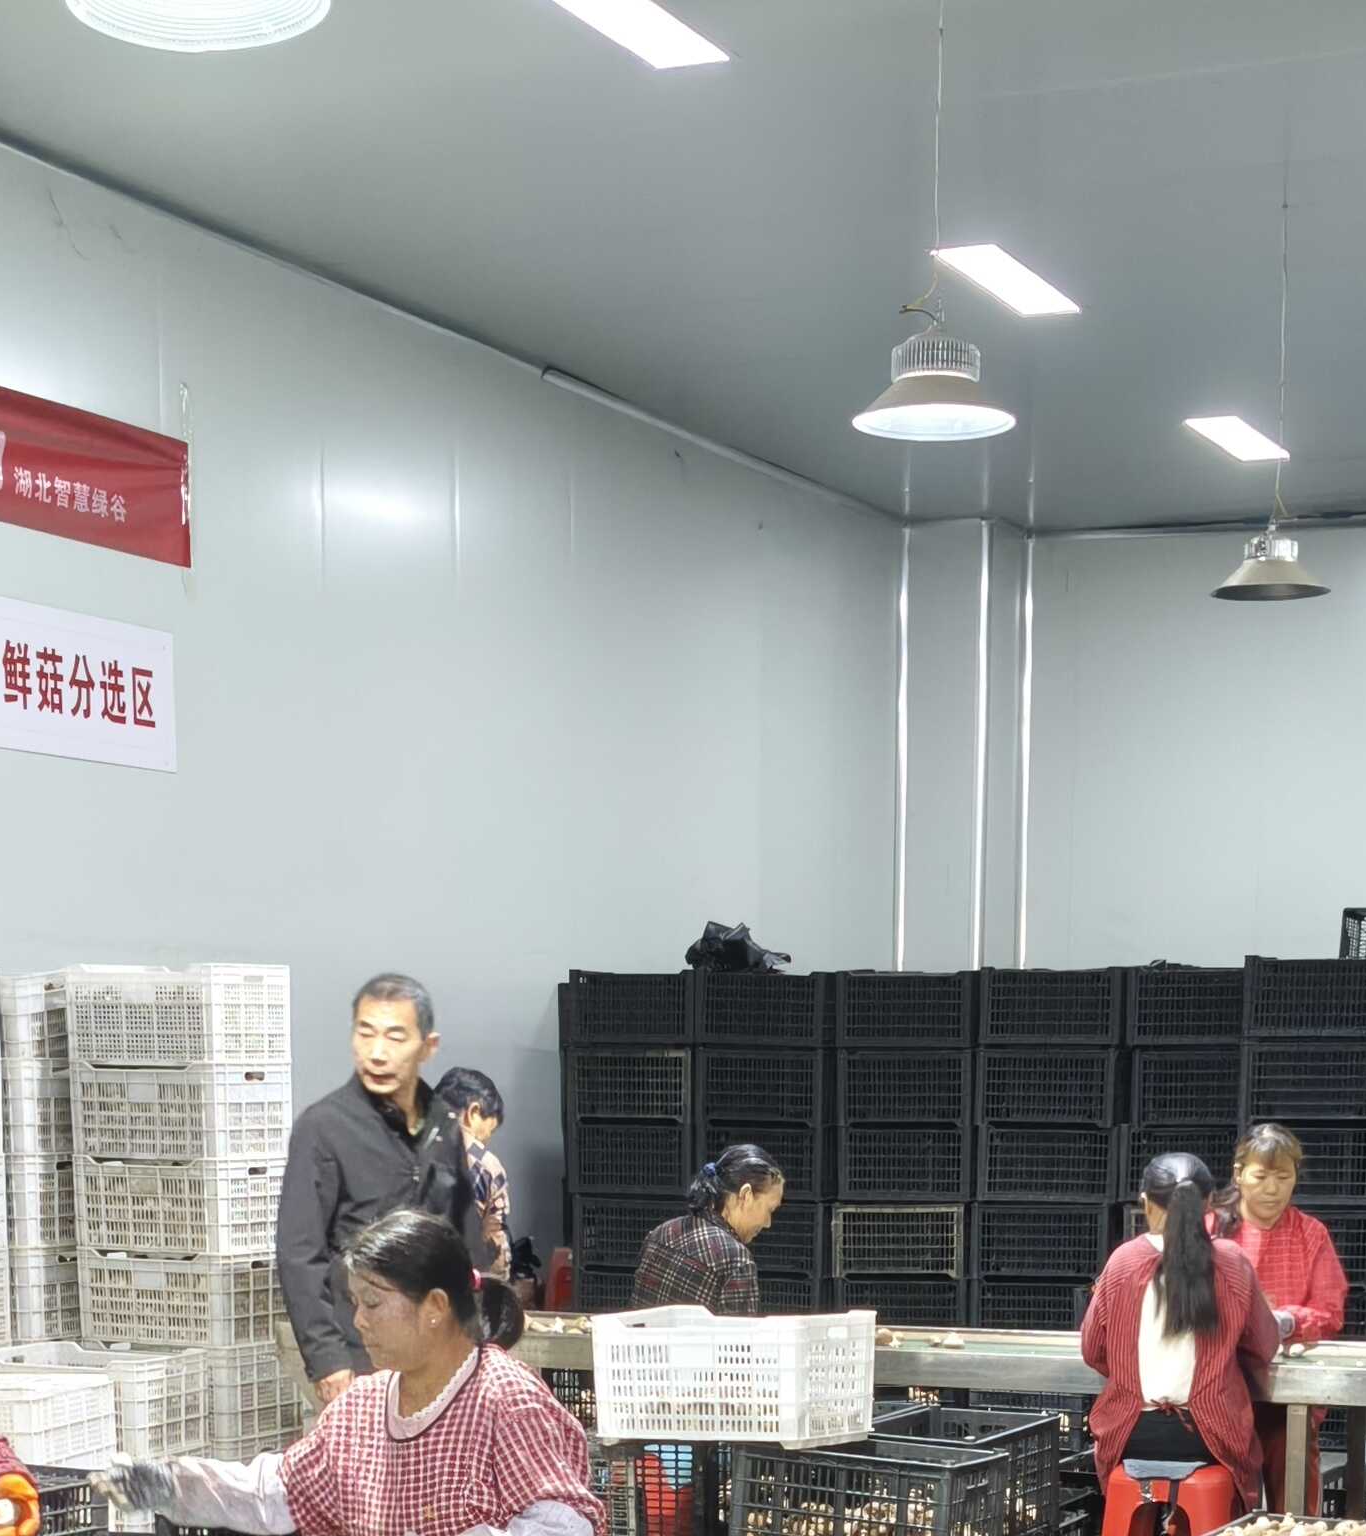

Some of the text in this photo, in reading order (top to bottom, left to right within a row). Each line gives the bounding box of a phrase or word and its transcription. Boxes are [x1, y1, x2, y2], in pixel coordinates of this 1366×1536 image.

[13, 466, 128, 522] 湖北智慧绿谷
[2, 639, 156, 728] 鲜菇分选区
